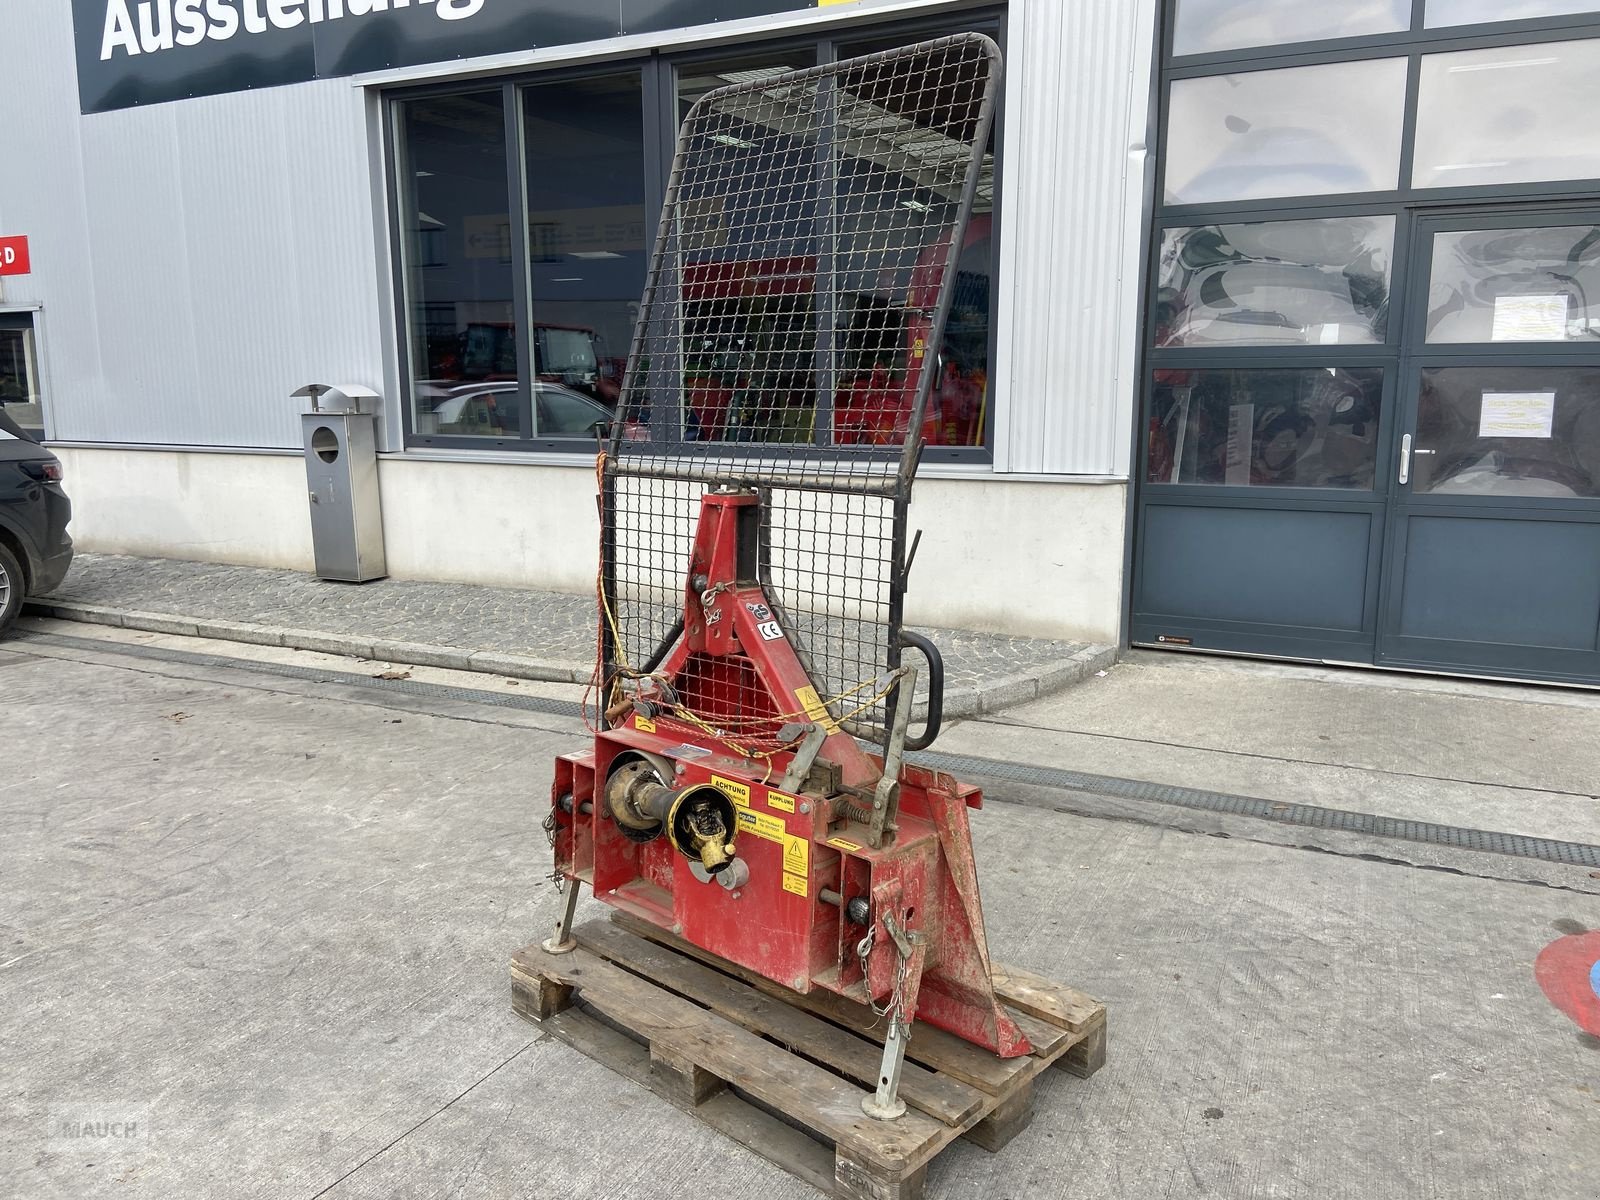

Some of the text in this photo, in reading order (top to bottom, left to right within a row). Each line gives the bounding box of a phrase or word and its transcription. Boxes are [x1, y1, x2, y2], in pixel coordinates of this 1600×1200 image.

[762, 623, 779, 637] CE
[715, 780, 746, 796] ACHTUNG
[769, 793, 794, 806] KUPPLUNG
